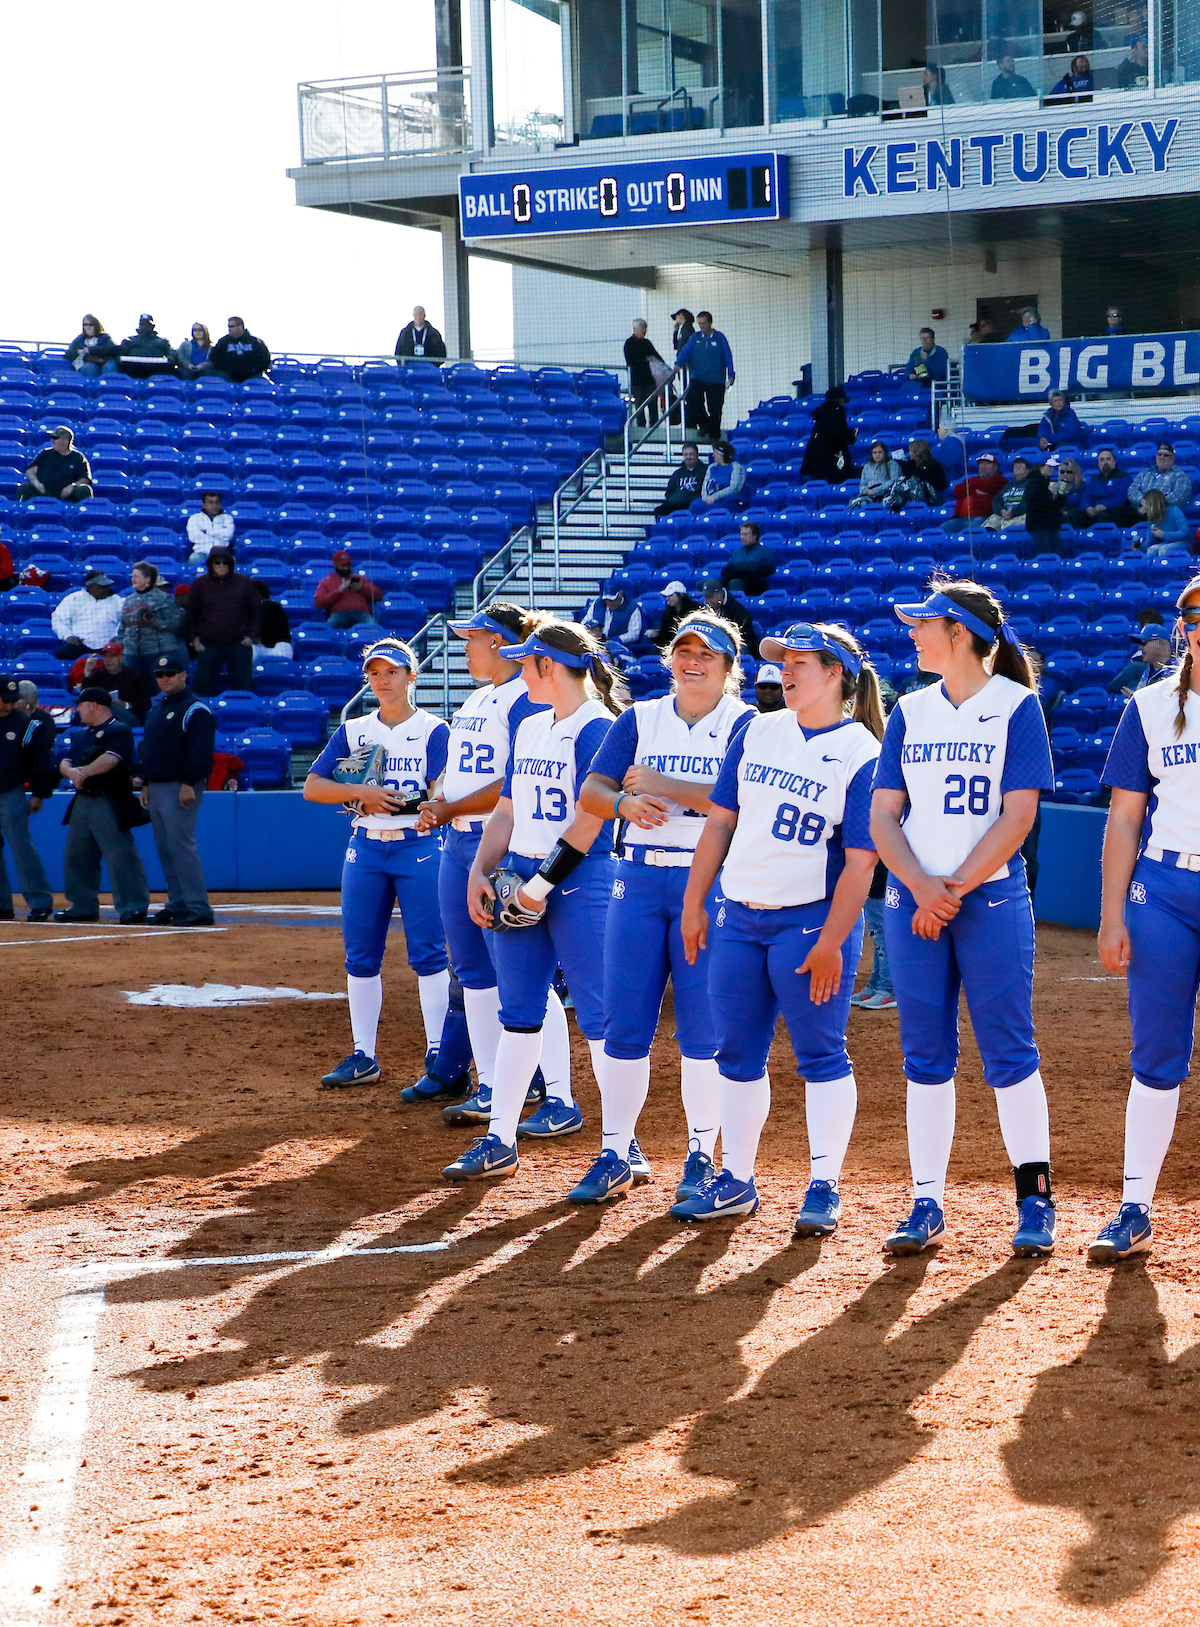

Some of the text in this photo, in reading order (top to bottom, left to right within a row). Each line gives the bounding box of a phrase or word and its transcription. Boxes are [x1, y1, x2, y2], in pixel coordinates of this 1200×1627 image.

[843, 118, 1180, 198] KENTUCKY
[465, 167, 772, 222] BALL 0 STRIKE 0 OUT 0 INN 1
[1018, 344, 1109, 394] BIG
[506, 651, 526, 659] SOFTBALL
[358, 734, 366, 747] C
[459, 741, 495, 773] 22
[902, 742, 996, 765] KENTUCKY
[641, 755, 723, 776] ENTUCKY
[743, 763, 828, 803] KENTUCKY
[531, 785, 568, 822] 13
[943, 774, 991, 816] 28
[771, 802, 826, 846] 88
